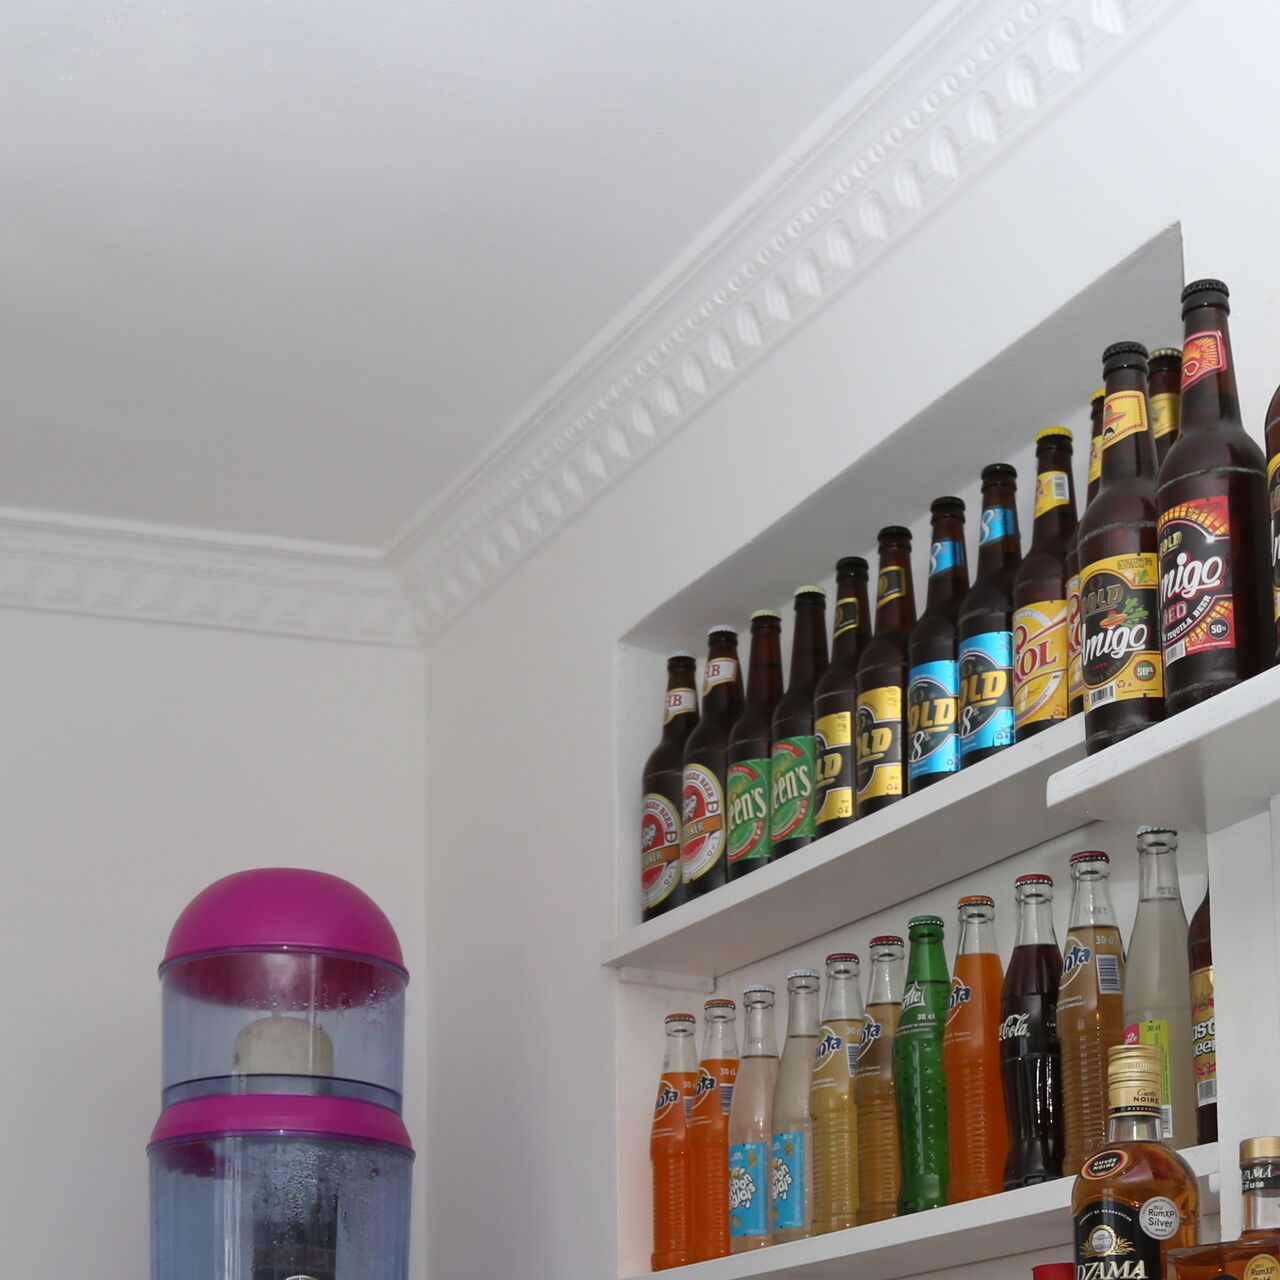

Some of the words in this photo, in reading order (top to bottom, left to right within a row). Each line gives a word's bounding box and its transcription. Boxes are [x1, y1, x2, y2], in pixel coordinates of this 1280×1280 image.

[1161, 552, 1223, 603] migo
[1167, 619, 1192, 642] TEQUILA
[1193, 595, 1211, 618] BEER
[700, 777, 715, 800] BEER
[659, 807, 674, 829] BEER
[1061, 946, 1091, 976] nta
[720, 1068, 729, 1076] 30
[1133, 1097, 1158, 1105] NOIRE
[1092, 1163, 1115, 1172] NOIRE
[1148, 1209, 1174, 1218] RumXP
[1148, 1217, 1173, 1228] Silver
[1250, 1267, 1275, 1277] RumXP
